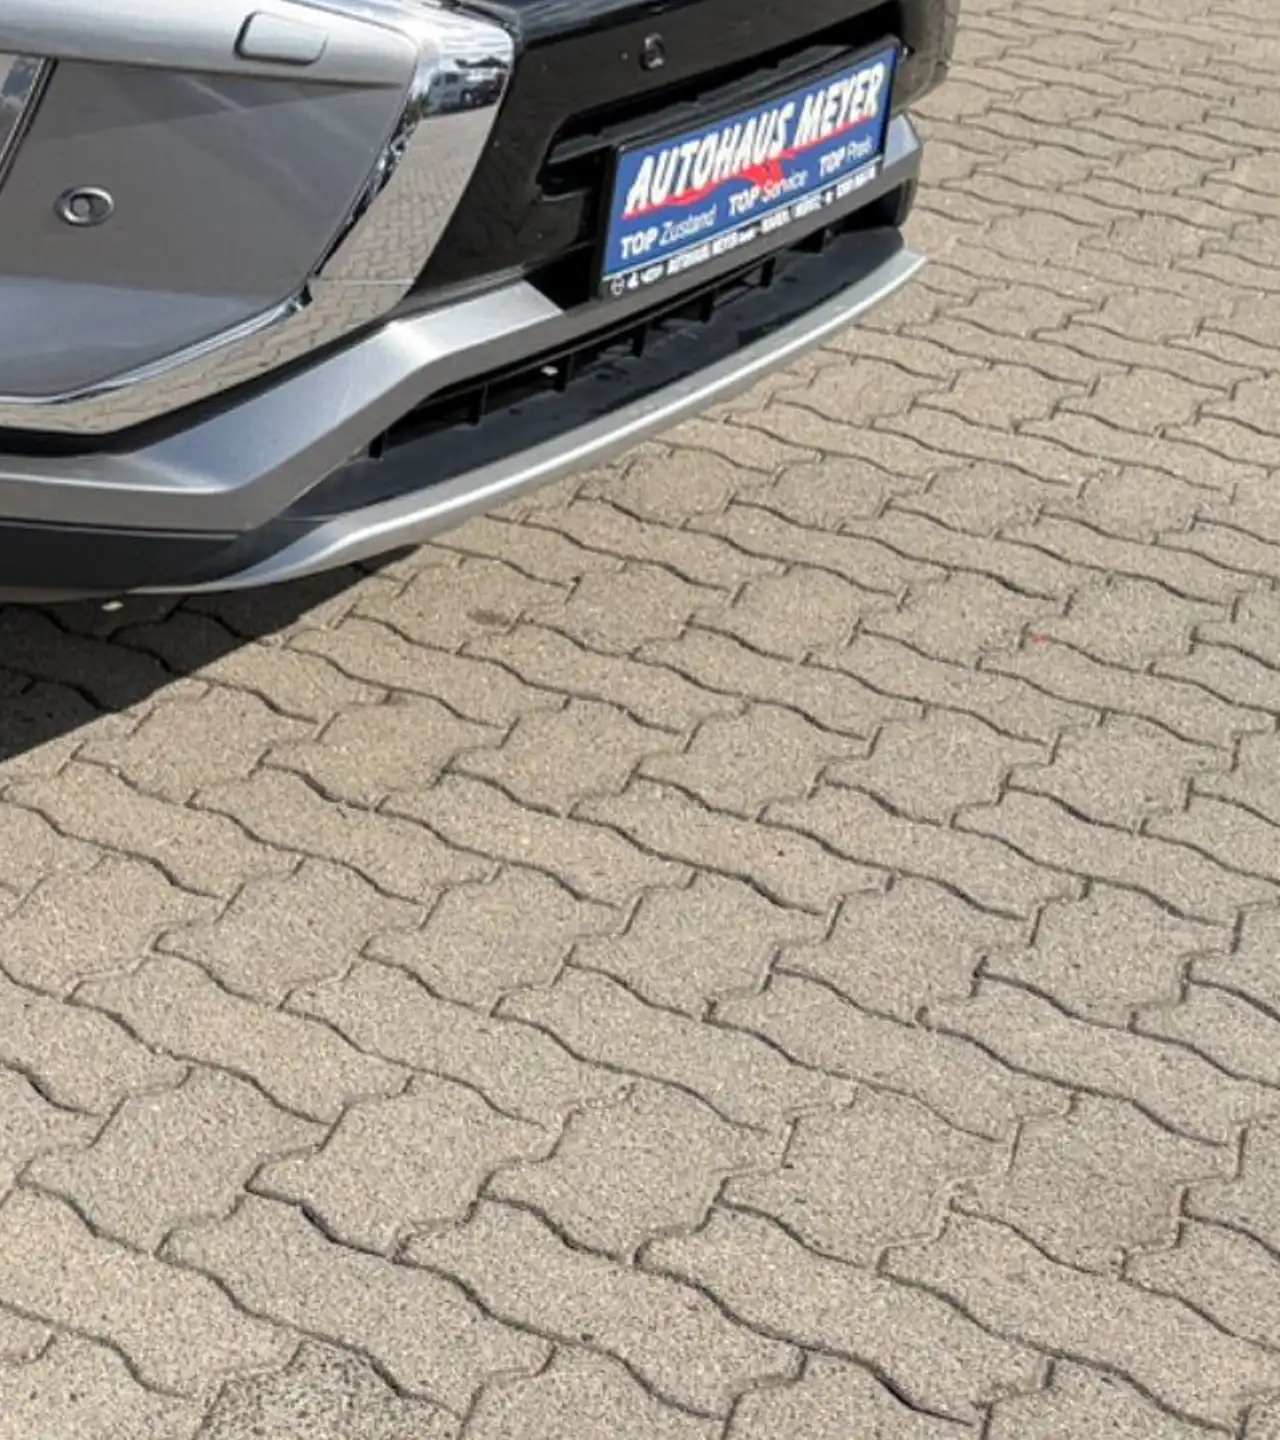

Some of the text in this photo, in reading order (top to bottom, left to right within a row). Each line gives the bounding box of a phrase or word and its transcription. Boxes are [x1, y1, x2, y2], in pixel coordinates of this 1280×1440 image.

[620, 225, 659, 259] TOP
[658, 203, 718, 247] Zustand
[728, 184, 761, 217] TOP
[760, 169, 808, 203] Service
[820, 145, 846, 177] TOP
[624, 62, 885, 216] AUTOHAUS MEYER
